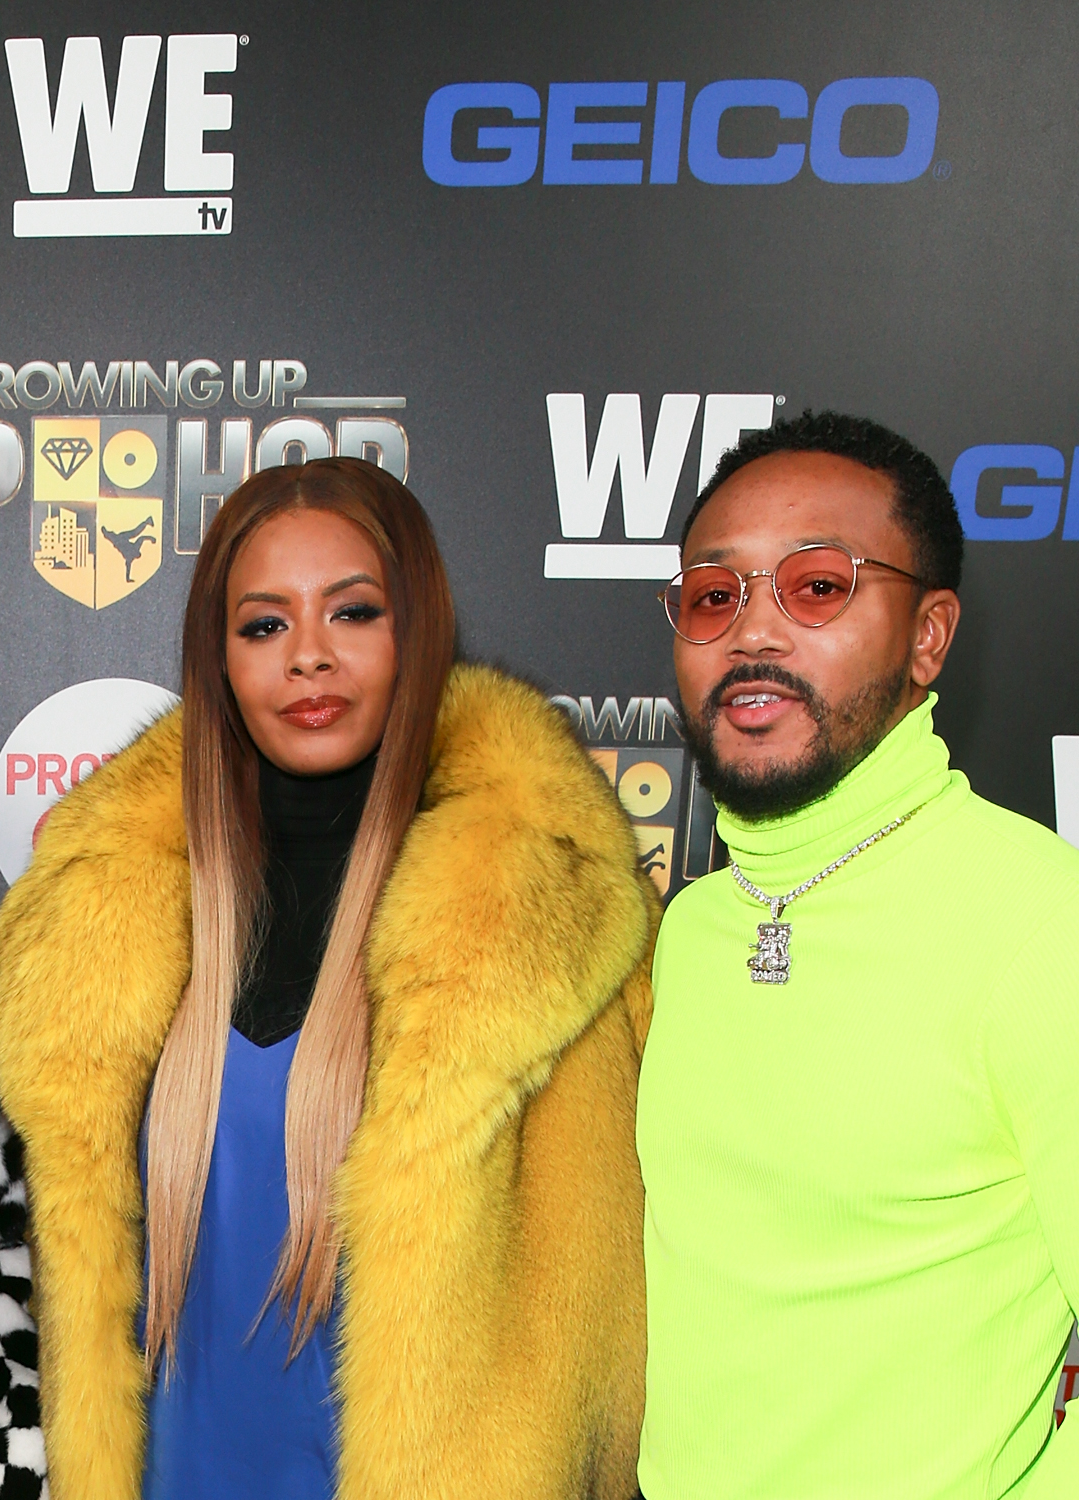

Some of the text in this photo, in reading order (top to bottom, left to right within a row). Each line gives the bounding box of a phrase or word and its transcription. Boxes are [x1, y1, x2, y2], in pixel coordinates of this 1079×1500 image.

[4, 33, 238, 193] WE
[422, 77, 940, 187] GEICO
[198, 202, 227, 230] tv
[232, 358, 308, 405] UP
